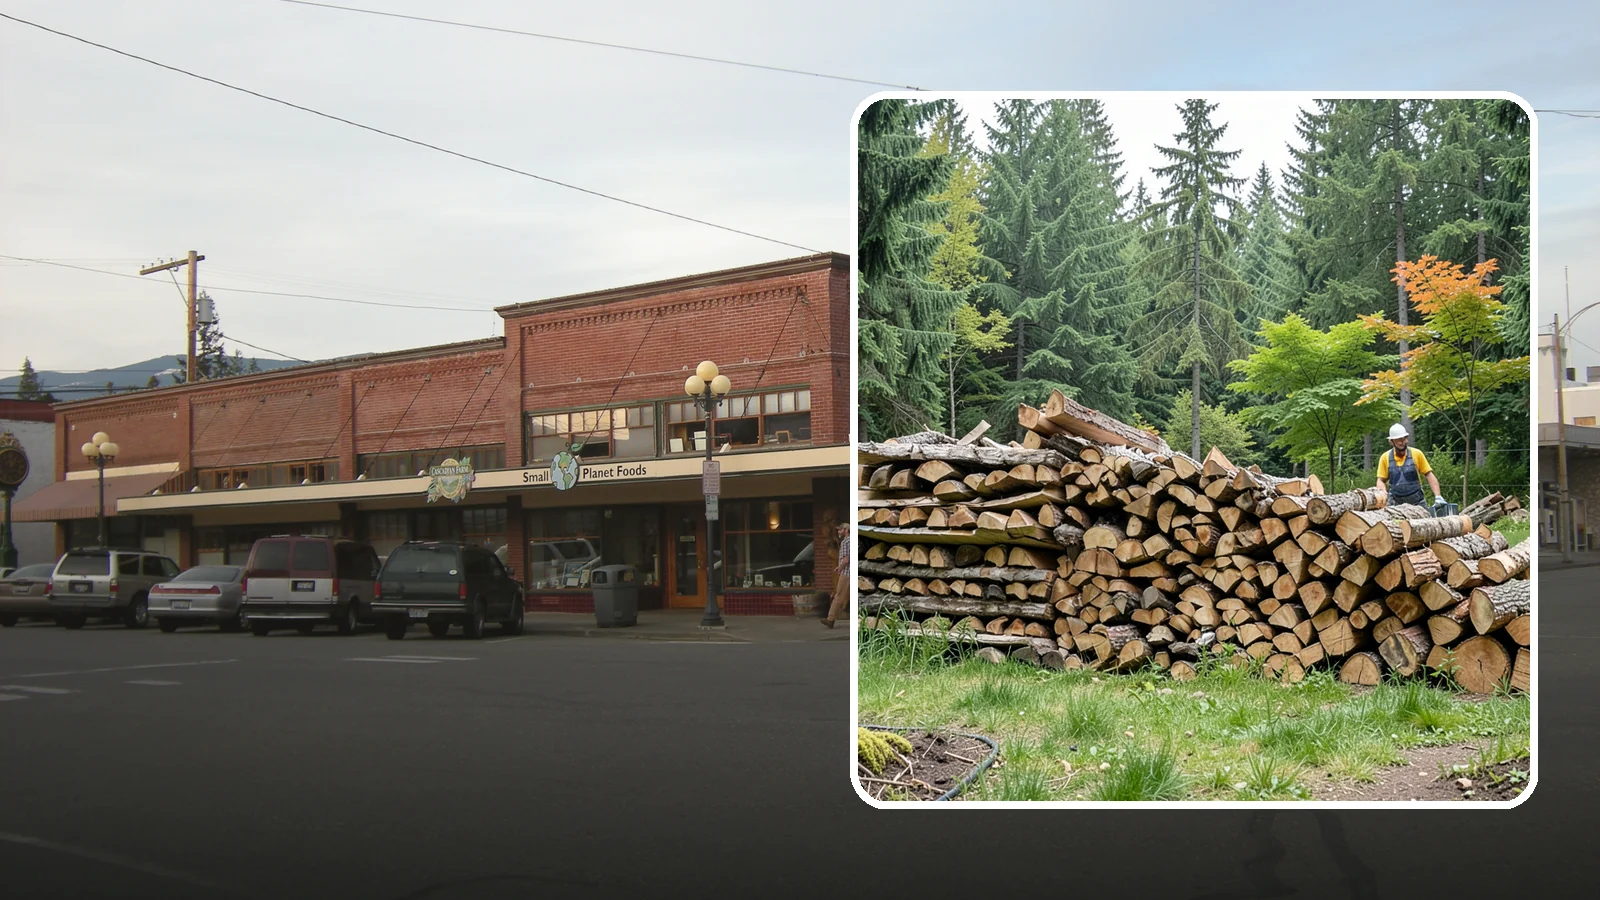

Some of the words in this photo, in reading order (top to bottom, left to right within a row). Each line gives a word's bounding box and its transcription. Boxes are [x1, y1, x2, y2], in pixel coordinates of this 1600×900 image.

[523, 470, 549, 482] Small
[583, 467, 614, 479] Planet
[616, 464, 647, 477] Foods
